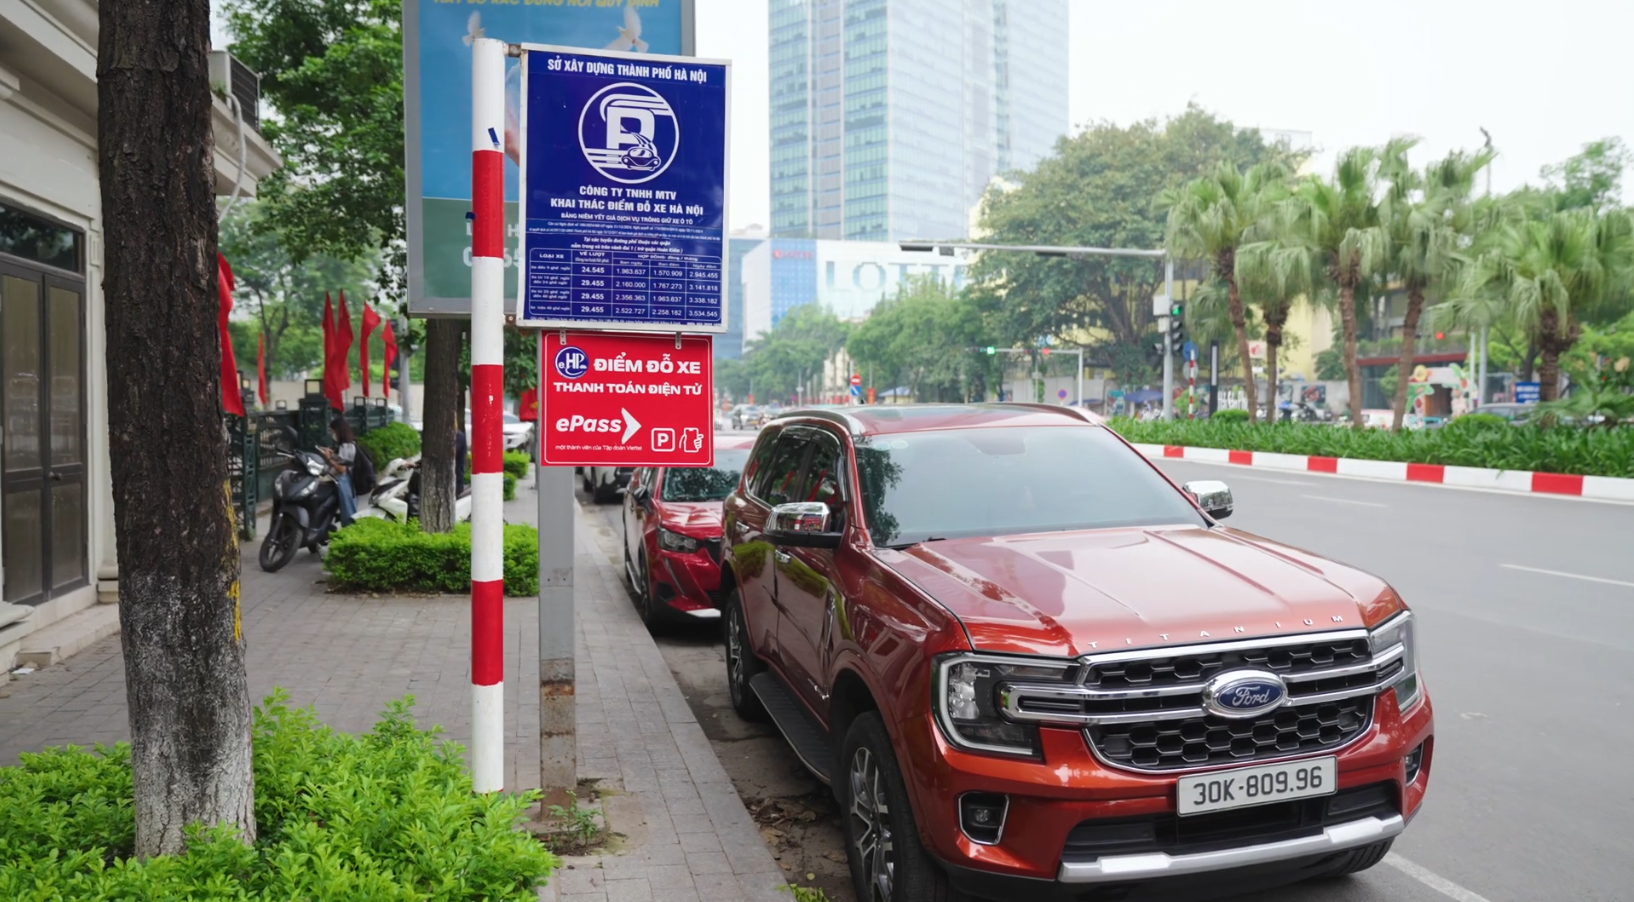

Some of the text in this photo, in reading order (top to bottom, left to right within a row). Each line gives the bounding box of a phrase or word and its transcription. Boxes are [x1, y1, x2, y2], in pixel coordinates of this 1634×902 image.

[548, 56, 707, 84] SỞ XÂY DỰNG THÀNH PHỐ HÀ NỘI
[580, 185, 676, 200] CÔNG TY TNHH MTV
[551, 198, 703, 217] KHAI THÁC ĐIỂM ĐỖ XE HÀ NỘI
[594, 352, 642, 372] ĐIỂM
[646, 354, 673, 373] ĐỖ
[677, 361, 701, 374] XE
[553, 381, 702, 396] THANH TOÁN ĐIỆN TỬ
[556, 415, 622, 433] ePass
[658, 433, 669, 446] P
[1088, 616, 1344, 648] TITANIUM
[1232, 685, 1269, 706] Ford
[1193, 766, 1322, 806] 30K-809.96
